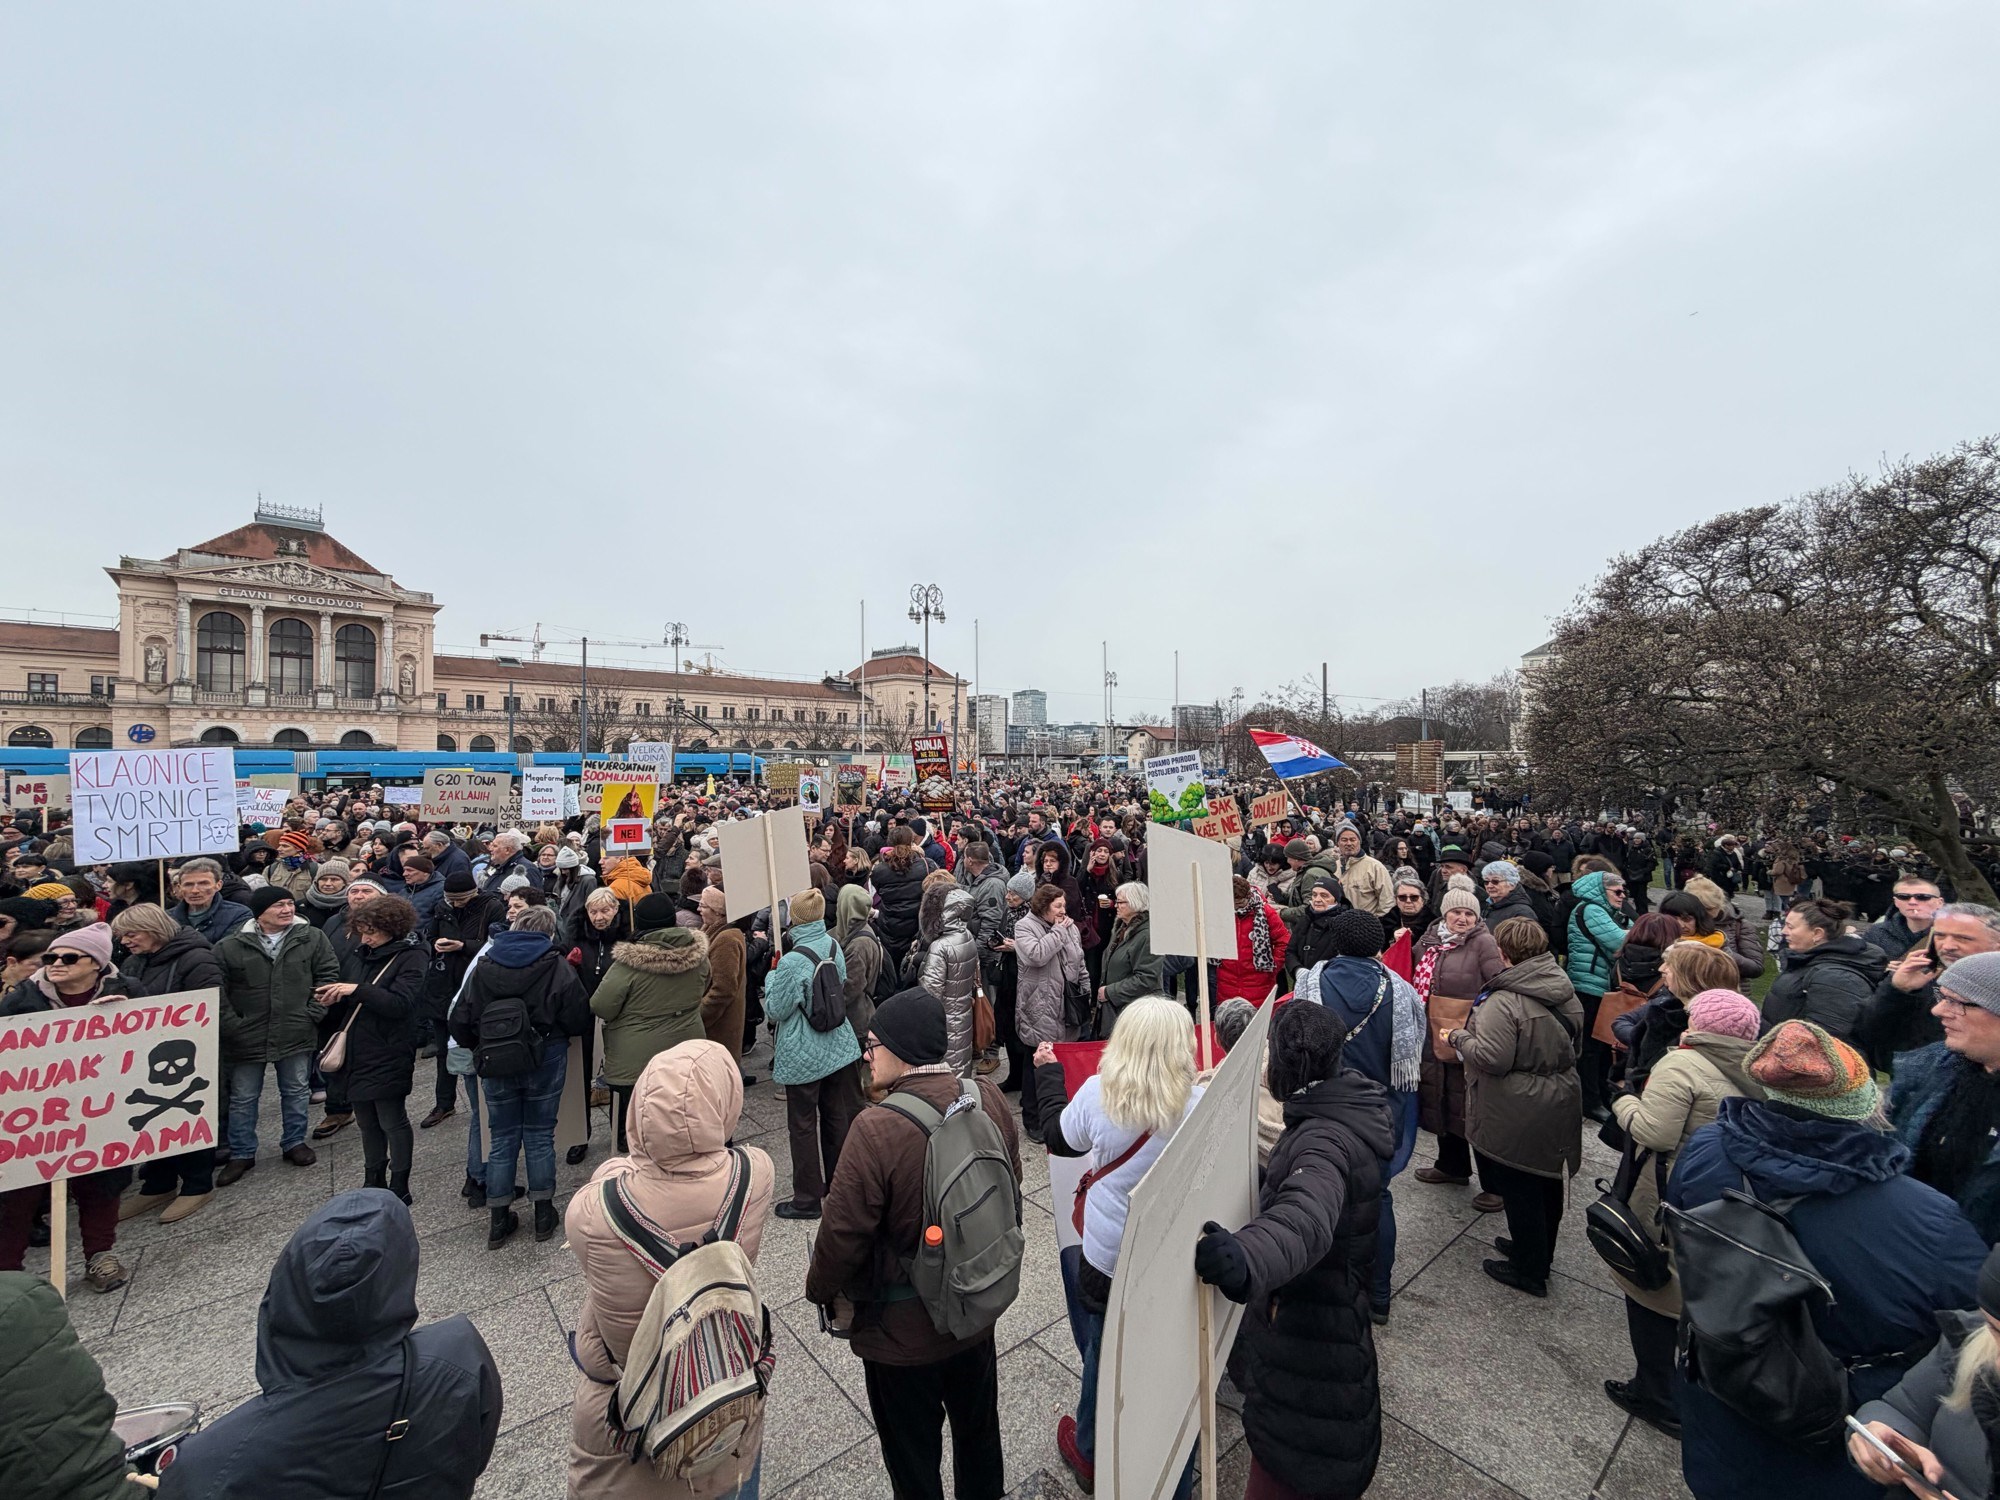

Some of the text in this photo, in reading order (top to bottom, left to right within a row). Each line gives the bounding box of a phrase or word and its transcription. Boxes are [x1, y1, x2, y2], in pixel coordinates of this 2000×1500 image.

[218, 587, 364, 609] GLAVNI KOLODVOR
[632, 745, 665, 754] VELIKA
[914, 739, 944, 752] SUNJA
[1171, 754, 1196, 764] PRIRODU
[75, 752, 219, 789] KLAONICE
[584, 760, 656, 772] NEVJEROJATNIH
[803, 768, 814, 777] NO
[1147, 763, 1200, 778] POŠTUJEMO ŽIVOTE
[434, 774, 497, 787] 620 TONA
[16, 782, 47, 795] NE
[255, 789, 276, 800] NE
[438, 790, 491, 802] ZAKLANIH
[531, 796, 556, 804] bolest
[76, 787, 222, 824] TVORNICE
[423, 803, 451, 815] PILIĆA
[531, 808, 557, 816] sutra!
[1209, 799, 1233, 816] SAK
[1253, 794, 1285, 819] ODLAZI!
[500, 821, 510, 829] NE
[1196, 813, 1243, 838] KAŽE NE!
[90, 818, 202, 862] SMRTI
[621, 829, 636, 839] NE!
[0, 1002, 210, 1053] ANTIBIOTICI,
[120, 1050, 135, 1075] I
[35, 1116, 213, 1181] VODAMA
